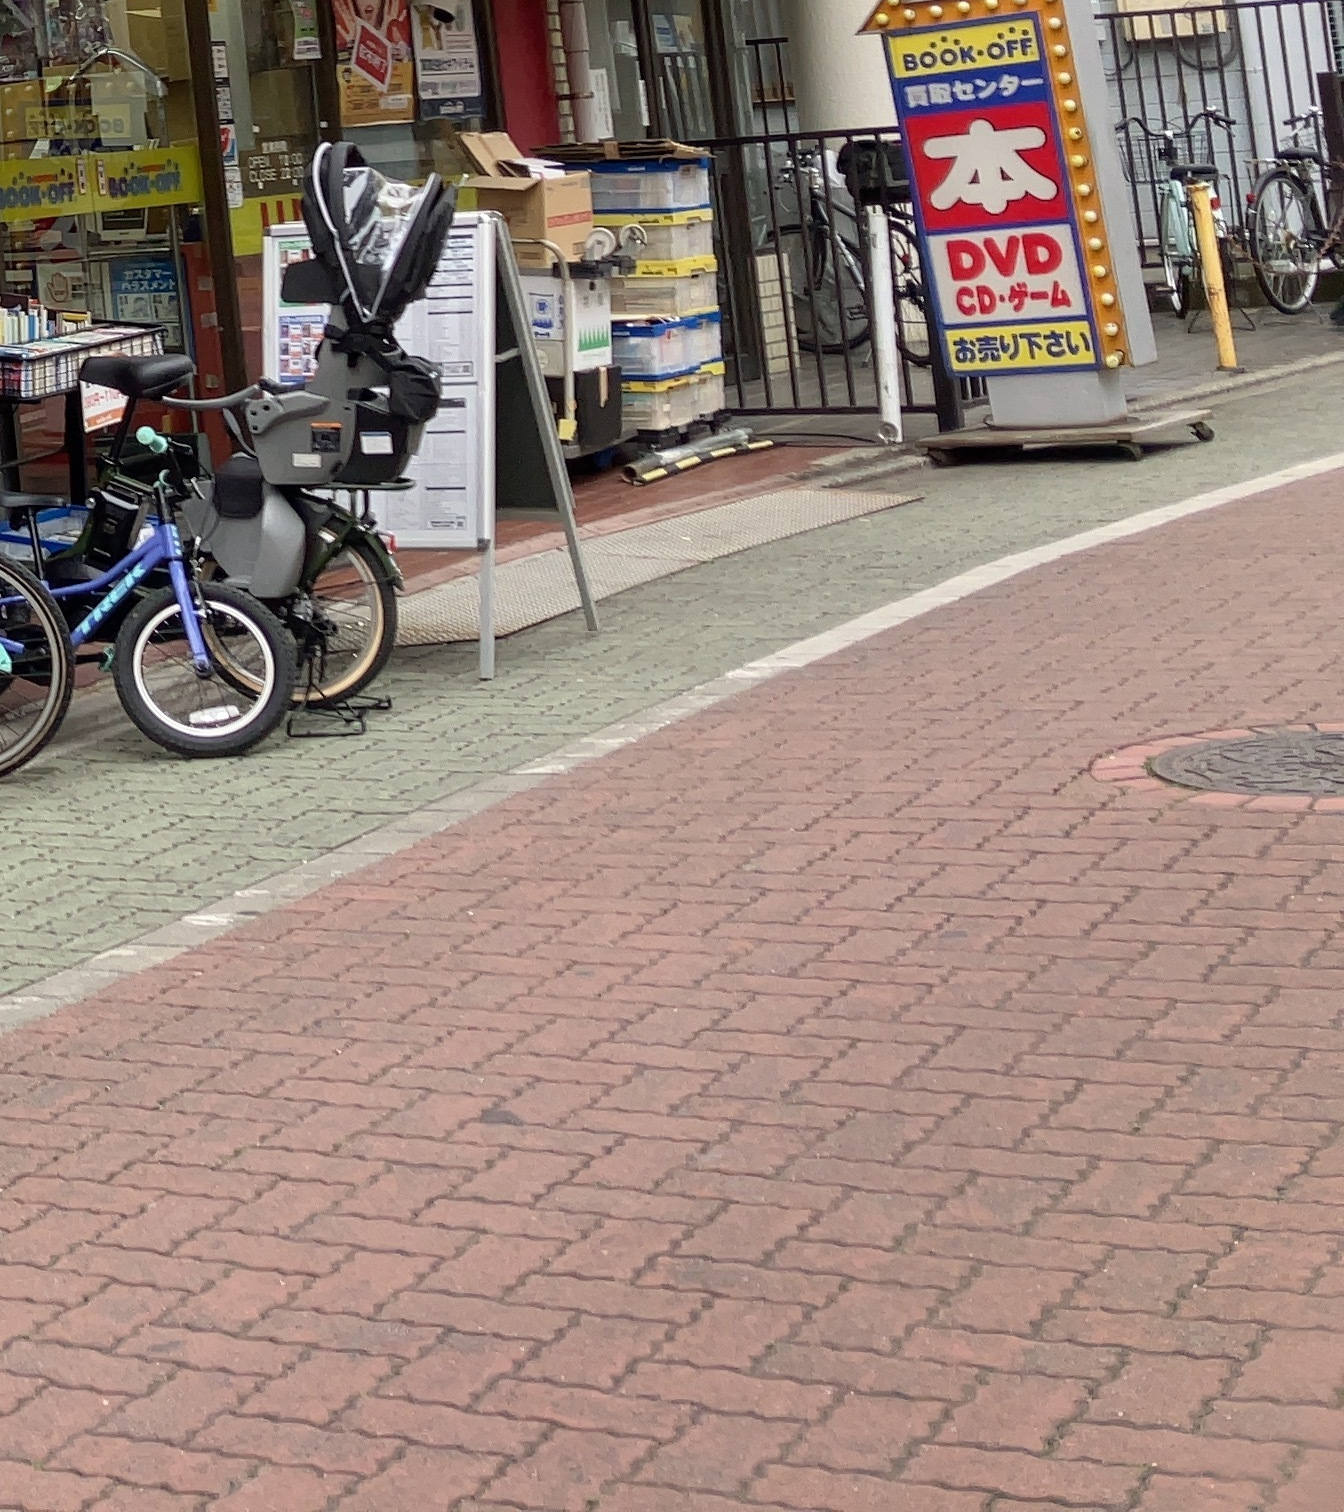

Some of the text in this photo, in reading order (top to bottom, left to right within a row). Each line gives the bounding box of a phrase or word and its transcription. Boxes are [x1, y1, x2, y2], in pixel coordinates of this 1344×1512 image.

[905, 74, 1044, 108] 買取センター
[923, 118, 1058, 215] 本
[946, 232, 1063, 281] DVD
[956, 280, 1072, 317] CD・ゲーム
[953, 330, 1091, 364] お売り下さい
